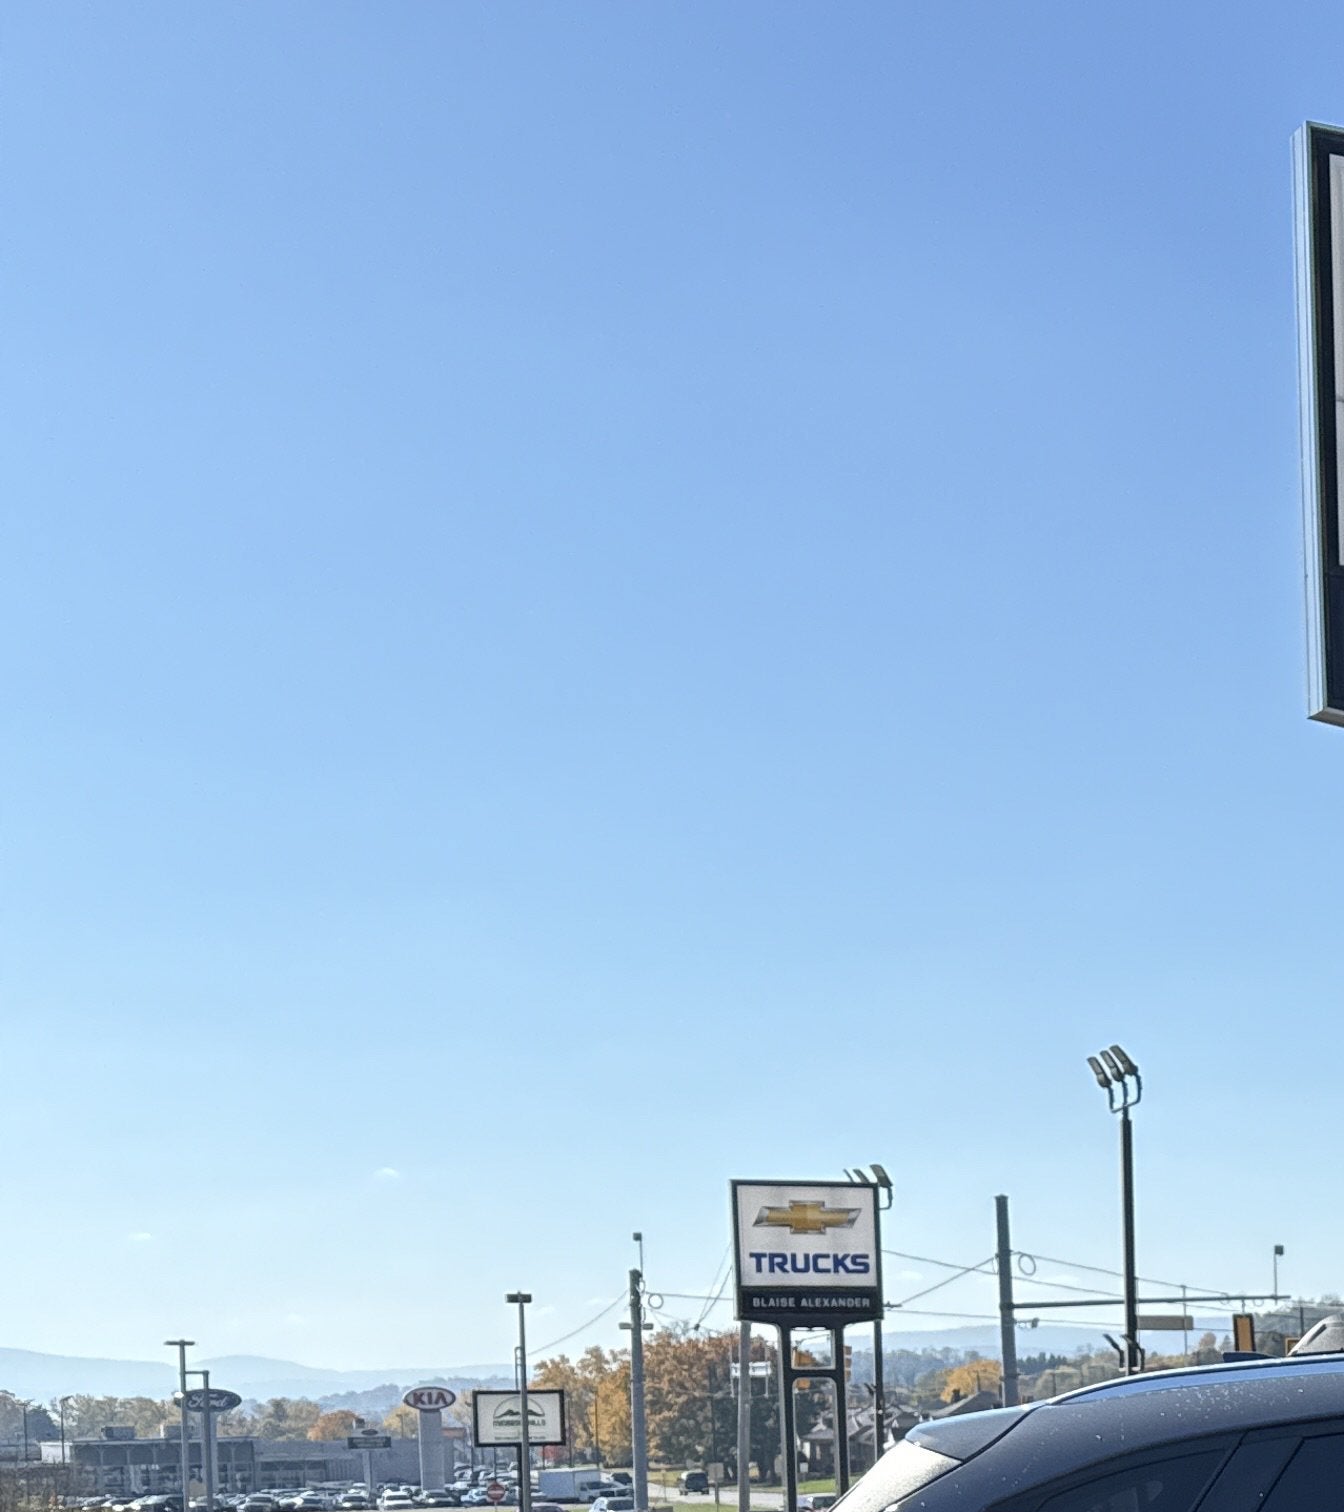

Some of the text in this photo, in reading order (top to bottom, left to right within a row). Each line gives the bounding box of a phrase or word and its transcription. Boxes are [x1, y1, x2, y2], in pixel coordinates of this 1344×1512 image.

[748, 1252, 871, 1274] TRUCKS
[752, 1297, 870, 1308] BLAISE ALEXANDER
[411, 1392, 449, 1406] KIA
